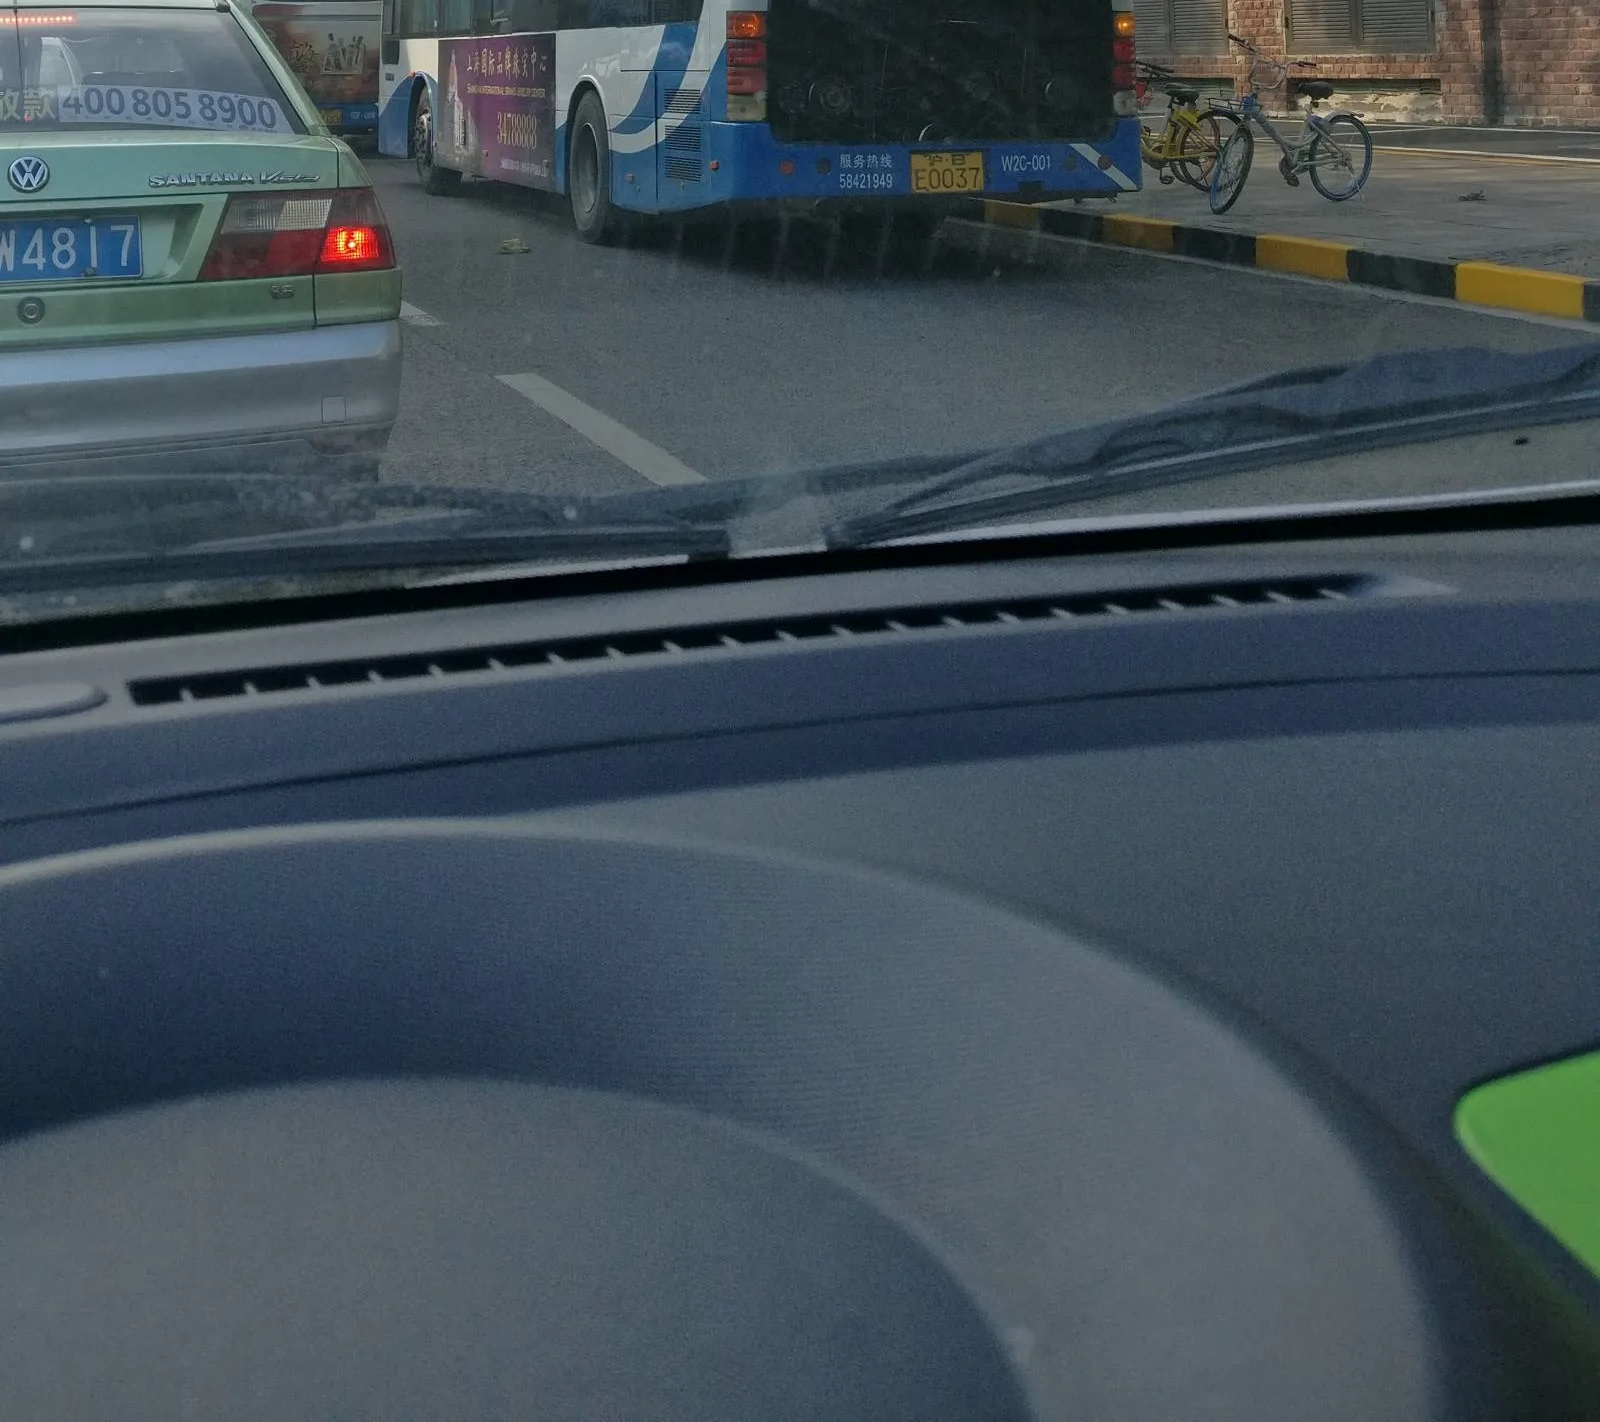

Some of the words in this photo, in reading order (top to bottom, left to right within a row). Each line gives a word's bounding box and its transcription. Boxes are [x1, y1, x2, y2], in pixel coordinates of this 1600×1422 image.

[62, 88, 125, 115] 400
[132, 89, 192, 119] 805
[199, 93, 277, 129] 8900
[840, 154, 893, 168] 服务热线
[149, 171, 254, 188] SANTANA
[840, 173, 893, 189] 58421949
[915, 167, 980, 190] E0037
